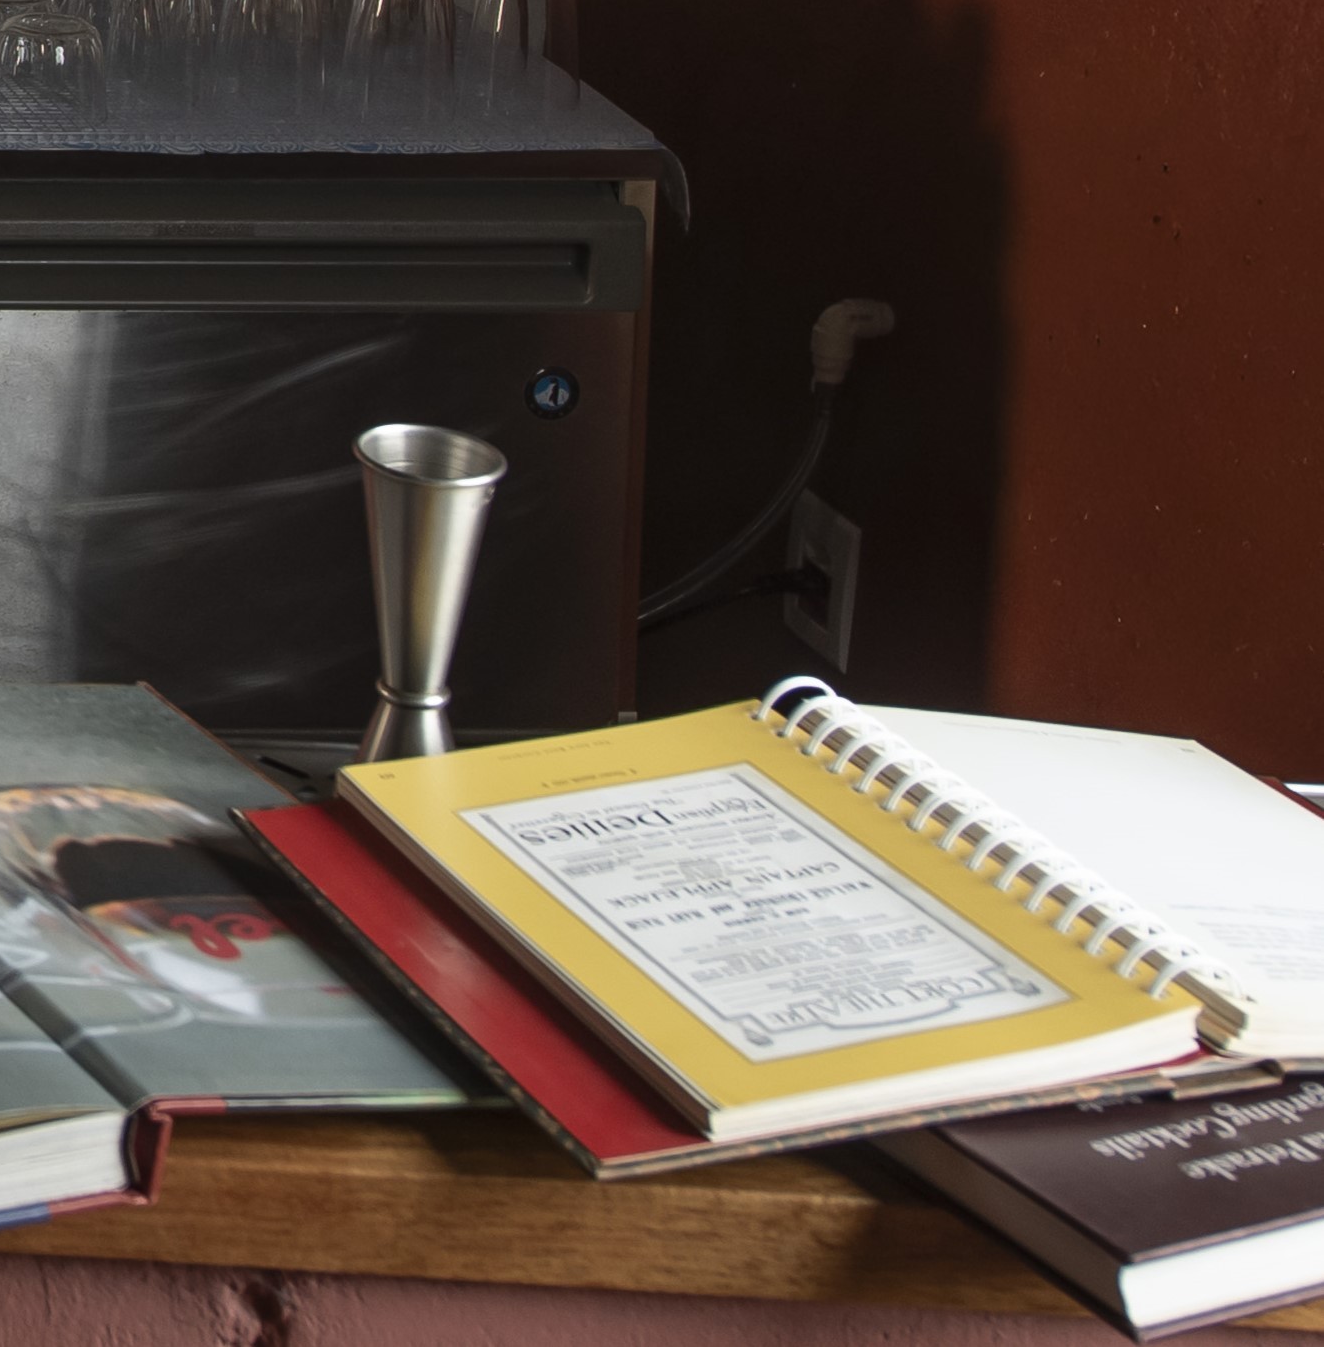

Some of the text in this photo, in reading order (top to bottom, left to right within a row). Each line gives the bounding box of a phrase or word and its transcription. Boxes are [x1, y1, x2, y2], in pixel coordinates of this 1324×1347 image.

[517, 809, 675, 848] Deities
[606, 860, 841, 911] CAPTAIN APPLEJACK
[1088, 1114, 1238, 1162] Cocktails
